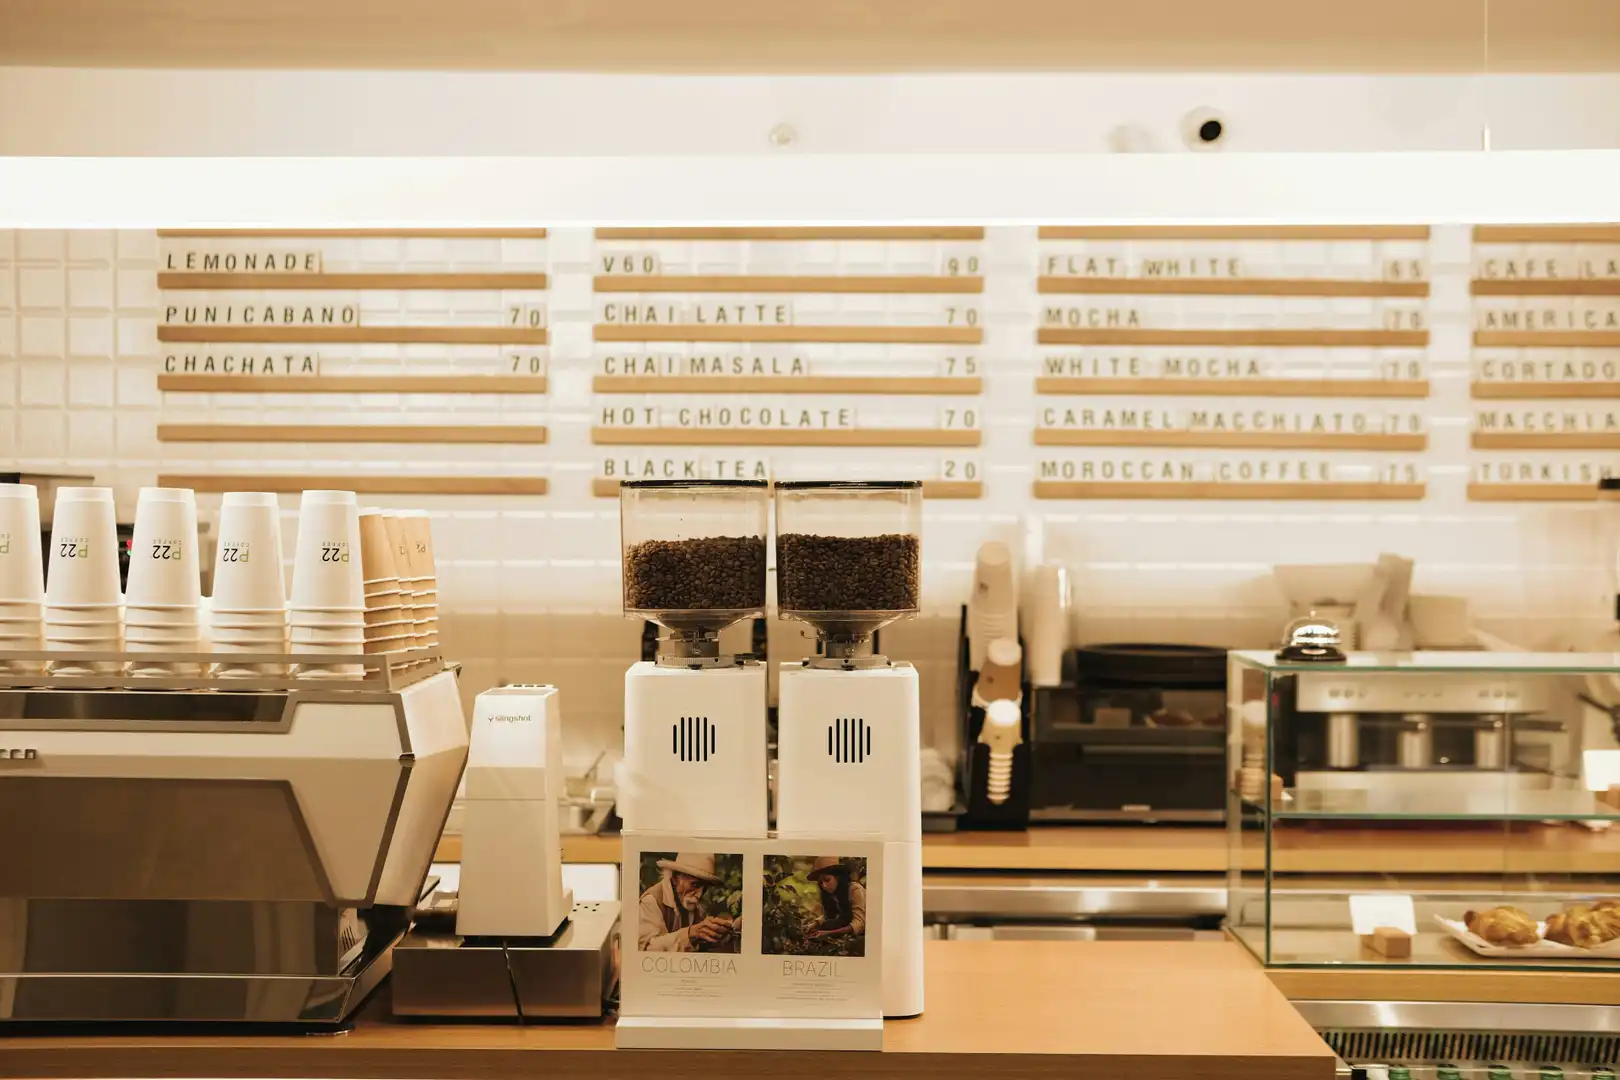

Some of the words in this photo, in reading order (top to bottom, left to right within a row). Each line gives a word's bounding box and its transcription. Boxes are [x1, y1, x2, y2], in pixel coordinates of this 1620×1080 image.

[167, 252, 314, 271] LEMONADE
[604, 255, 654, 274] V60
[947, 256, 979, 276] 90
[1047, 256, 1117, 275] FLAT
[1146, 258, 1239, 277] WHITE
[1485, 259, 1558, 278] CAFE
[166, 305, 354, 324] PUNICABANO
[510, 308, 540, 327] 70
[605, 304, 675, 323] CHAI
[697, 304, 786, 323] LATTE
[947, 307, 978, 327] 70
[1046, 308, 1140, 327] MOCHA
[1390, 311, 1422, 330] 70
[165, 355, 313, 374] CHACHATA
[511, 356, 540, 374] 70
[605, 356, 675, 374] CHAI
[691, 357, 804, 375] MASALA
[946, 357, 976, 375] 75
[1046, 357, 1140, 376] WHITE
[1164, 359, 1261, 377] MOCHA
[1389, 361, 1421, 379] 70
[1483, 360, 1617, 380] CORTADO
[602, 408, 654, 425] HOT
[679, 408, 849, 427] CHOCOLATE
[945, 410, 975, 428] 70
[1044, 408, 1174, 428] CARAMEL
[1191, 410, 1367, 431] MACCHIATO
[1390, 413, 1421, 433] 70
[605, 459, 695, 478] BLACK
[716, 460, 766, 478] TEA
[945, 460, 976, 480] 20
[1041, 460, 1194, 480] MOROCCAN
[1219, 461, 1330, 480] COFFEE
[60, 543, 88, 558] P22
[152, 545, 181, 560] P22
[223, 548, 249, 562] P22
[322, 548, 349, 562] P22
[641, 956, 737, 974] COLOMBIA
[782, 960, 842, 977] BRAZIL
